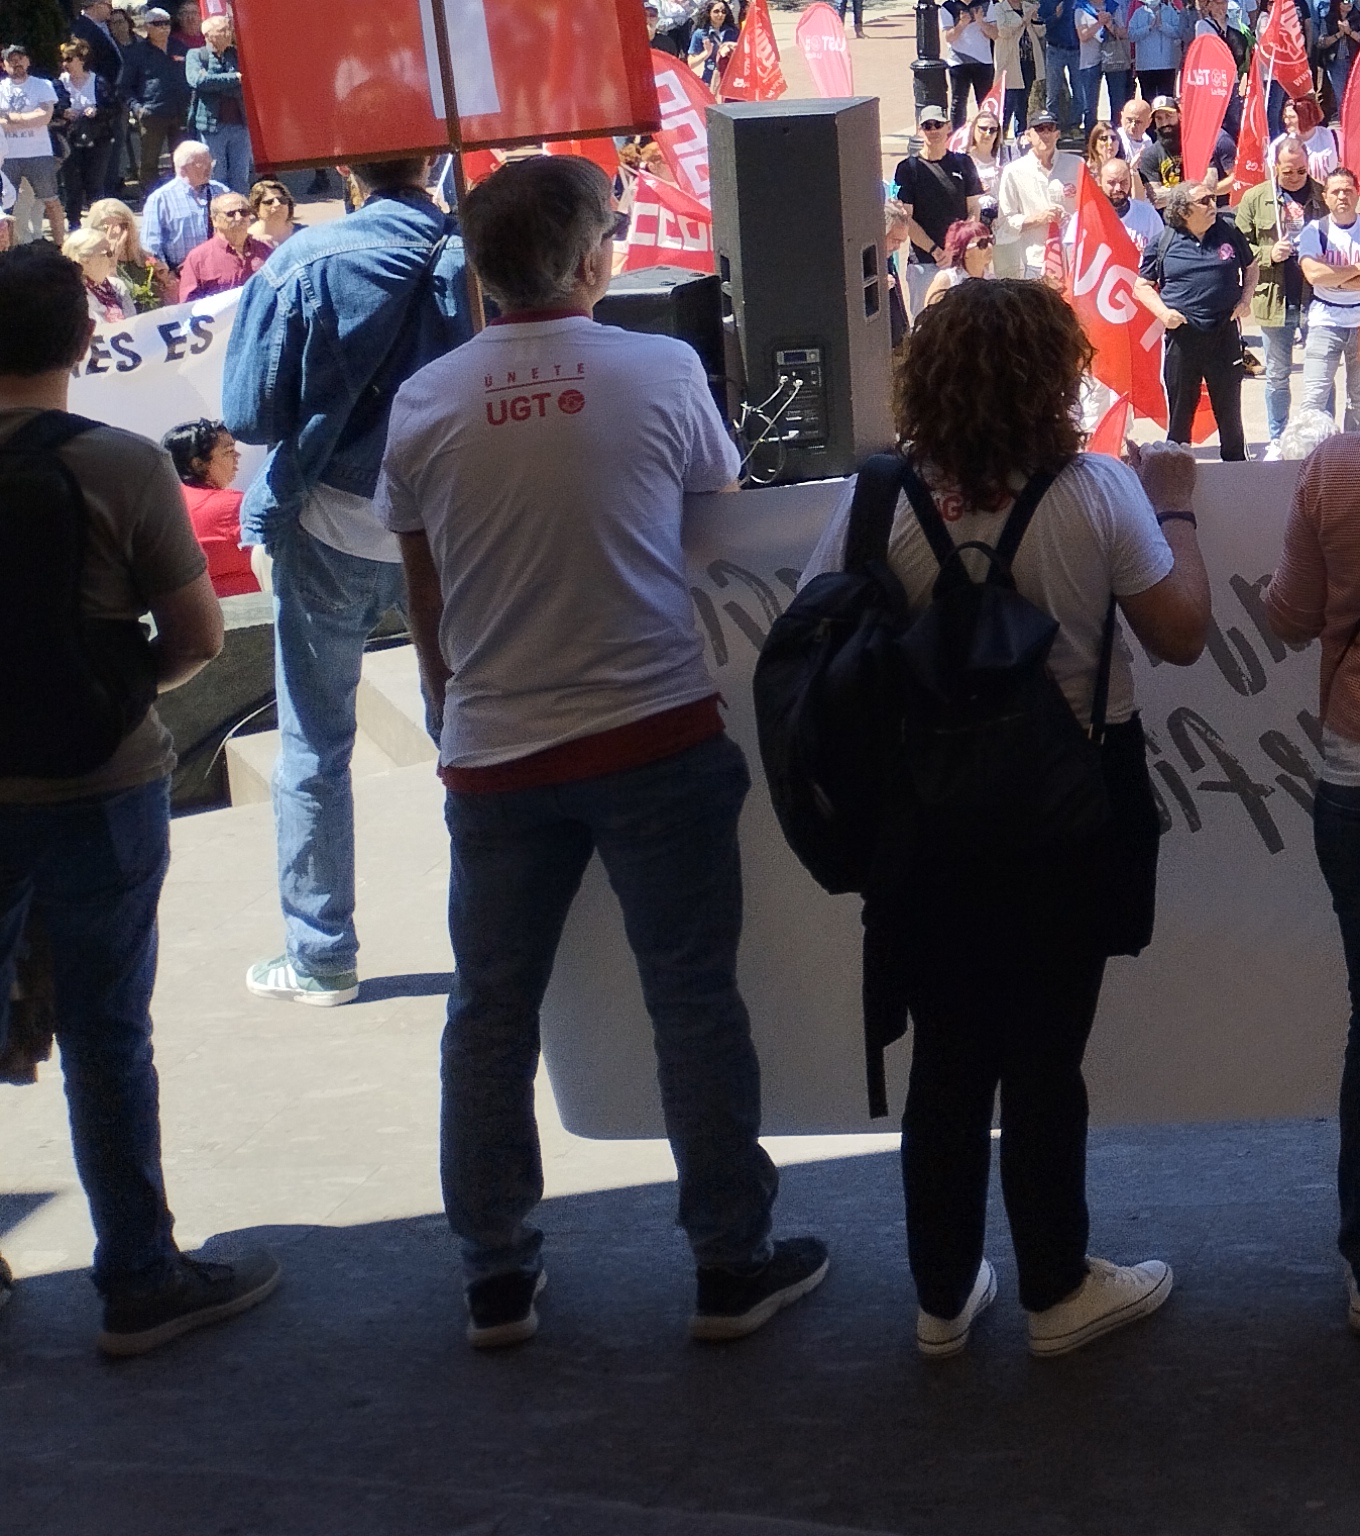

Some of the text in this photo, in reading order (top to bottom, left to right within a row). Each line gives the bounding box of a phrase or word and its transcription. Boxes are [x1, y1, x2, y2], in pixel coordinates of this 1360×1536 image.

[629, 203, 713, 252] CCO
[70, 315, 215, 379] ES ES
[484, 361, 586, 389] ÚNETE
[486, 392, 552, 427] UGT
